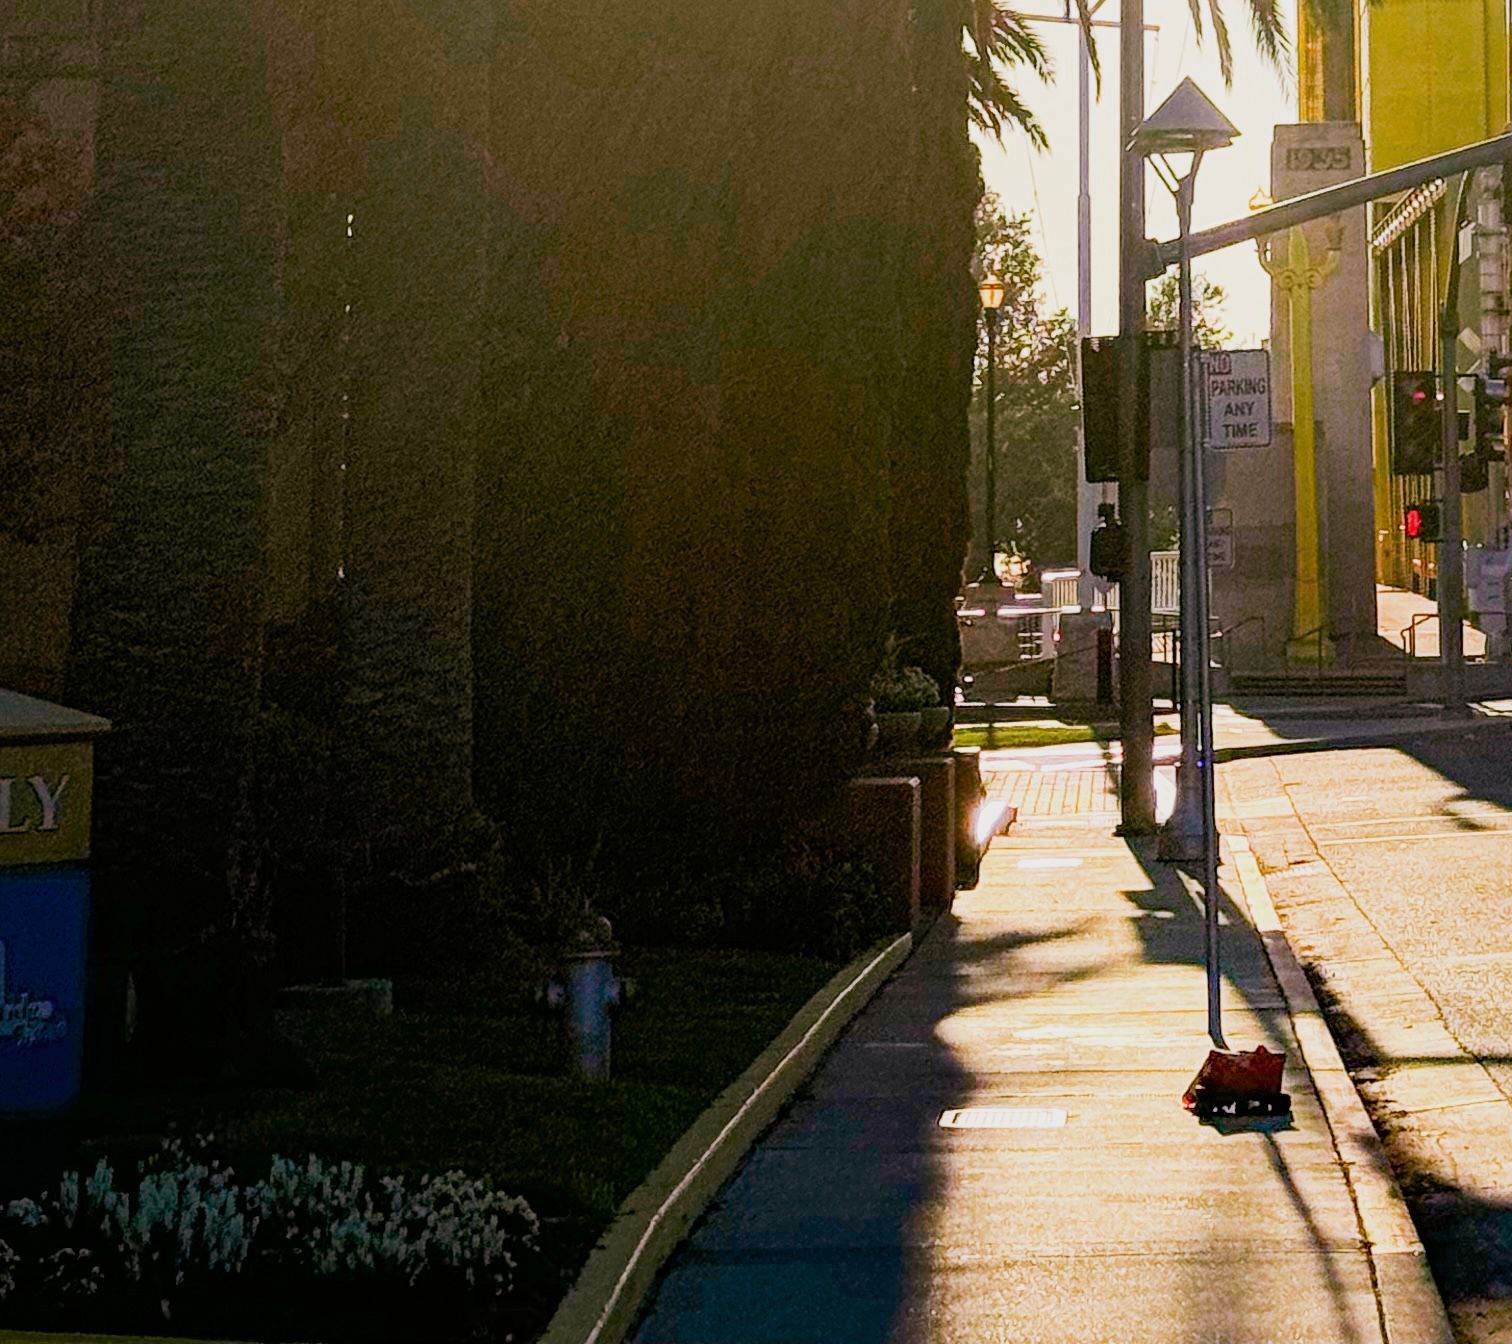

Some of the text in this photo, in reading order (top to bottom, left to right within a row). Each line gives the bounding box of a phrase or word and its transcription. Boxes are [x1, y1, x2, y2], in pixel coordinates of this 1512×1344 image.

[1288, 149, 1350, 170] 1935
[1209, 353, 1230, 372] NO
[1211, 378, 1266, 397] PARKING
[1223, 401, 1255, 417] ANY
[1221, 422, 1259, 438] TIME
